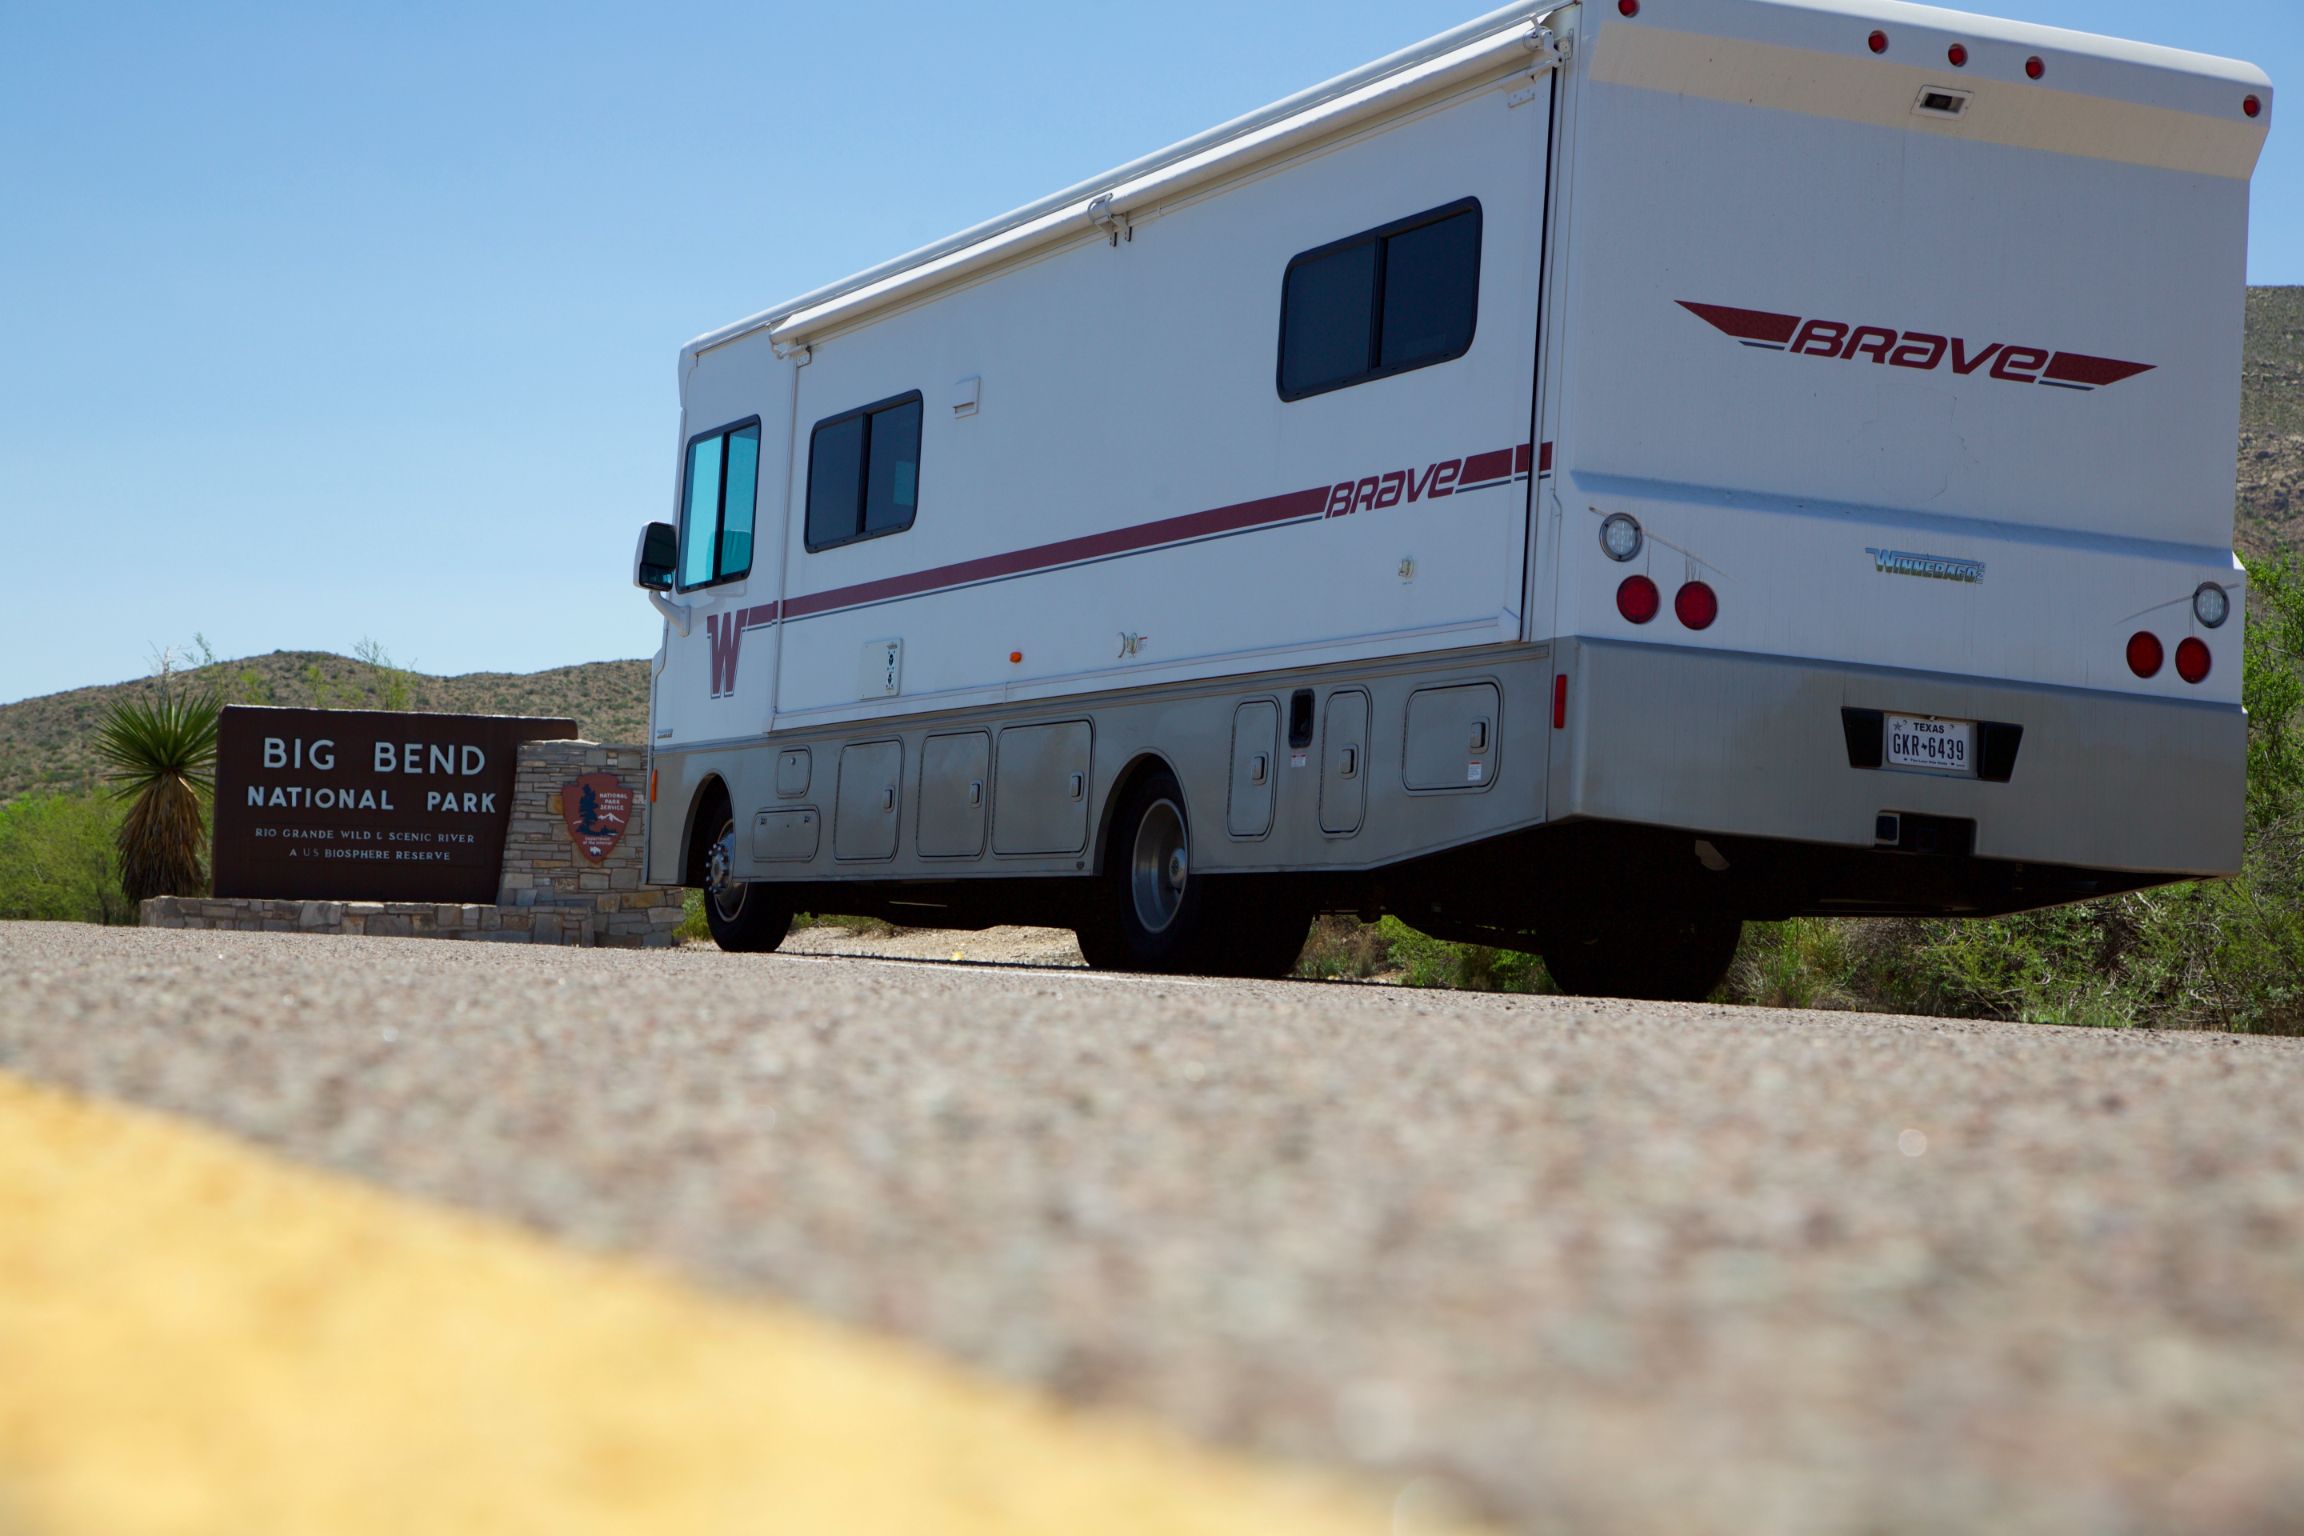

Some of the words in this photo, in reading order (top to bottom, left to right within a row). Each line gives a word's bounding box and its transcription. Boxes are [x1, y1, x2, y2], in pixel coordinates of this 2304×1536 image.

[706, 608, 749, 700] W
[1913, 722, 1945, 734] TEXAS
[263, 737, 335, 770] BIG
[374, 741, 486, 776] BEND
[247, 785, 394, 810] NATIONAL
[427, 791, 497, 814] PARK
[255, 827, 277, 838] RIO
[282, 828, 334, 840] GRANDE
[340, 830, 371, 840] WILD
[388, 831, 432, 842] SCENIC
[438, 833, 475, 843] RIVER
[289, 848, 297, 857] A
[324, 849, 390, 860] BIOSPHERE
[395, 850, 451, 861] RESERVE
